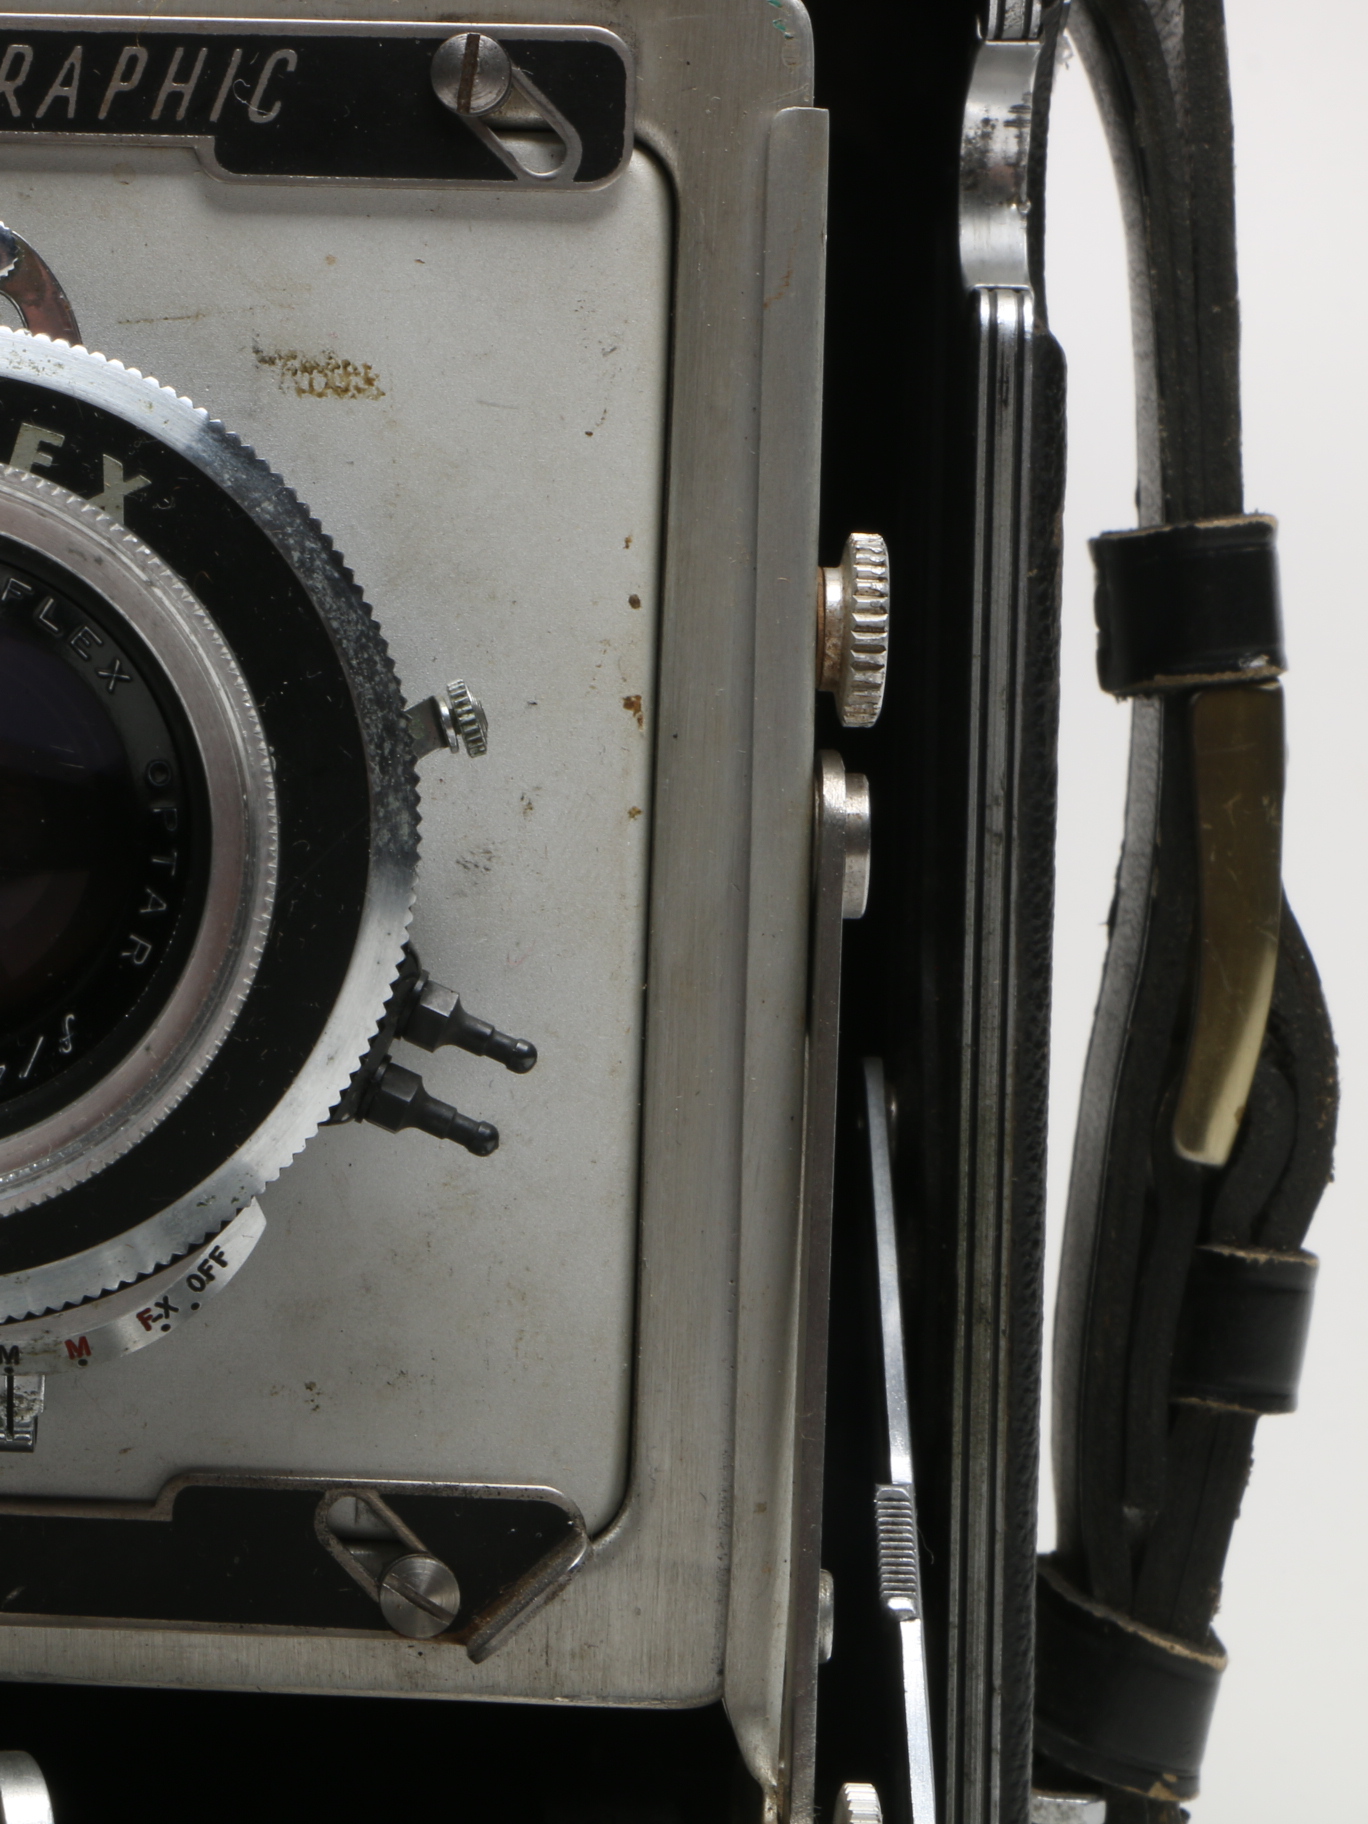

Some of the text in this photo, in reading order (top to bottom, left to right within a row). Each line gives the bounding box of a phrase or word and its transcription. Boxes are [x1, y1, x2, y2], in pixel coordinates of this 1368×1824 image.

[121, 759, 178, 967] OPTAR
[63, 1335, 93, 1361] M
[135, 1294, 180, 1332] F-X
[185, 1244, 229, 1293] OFF
